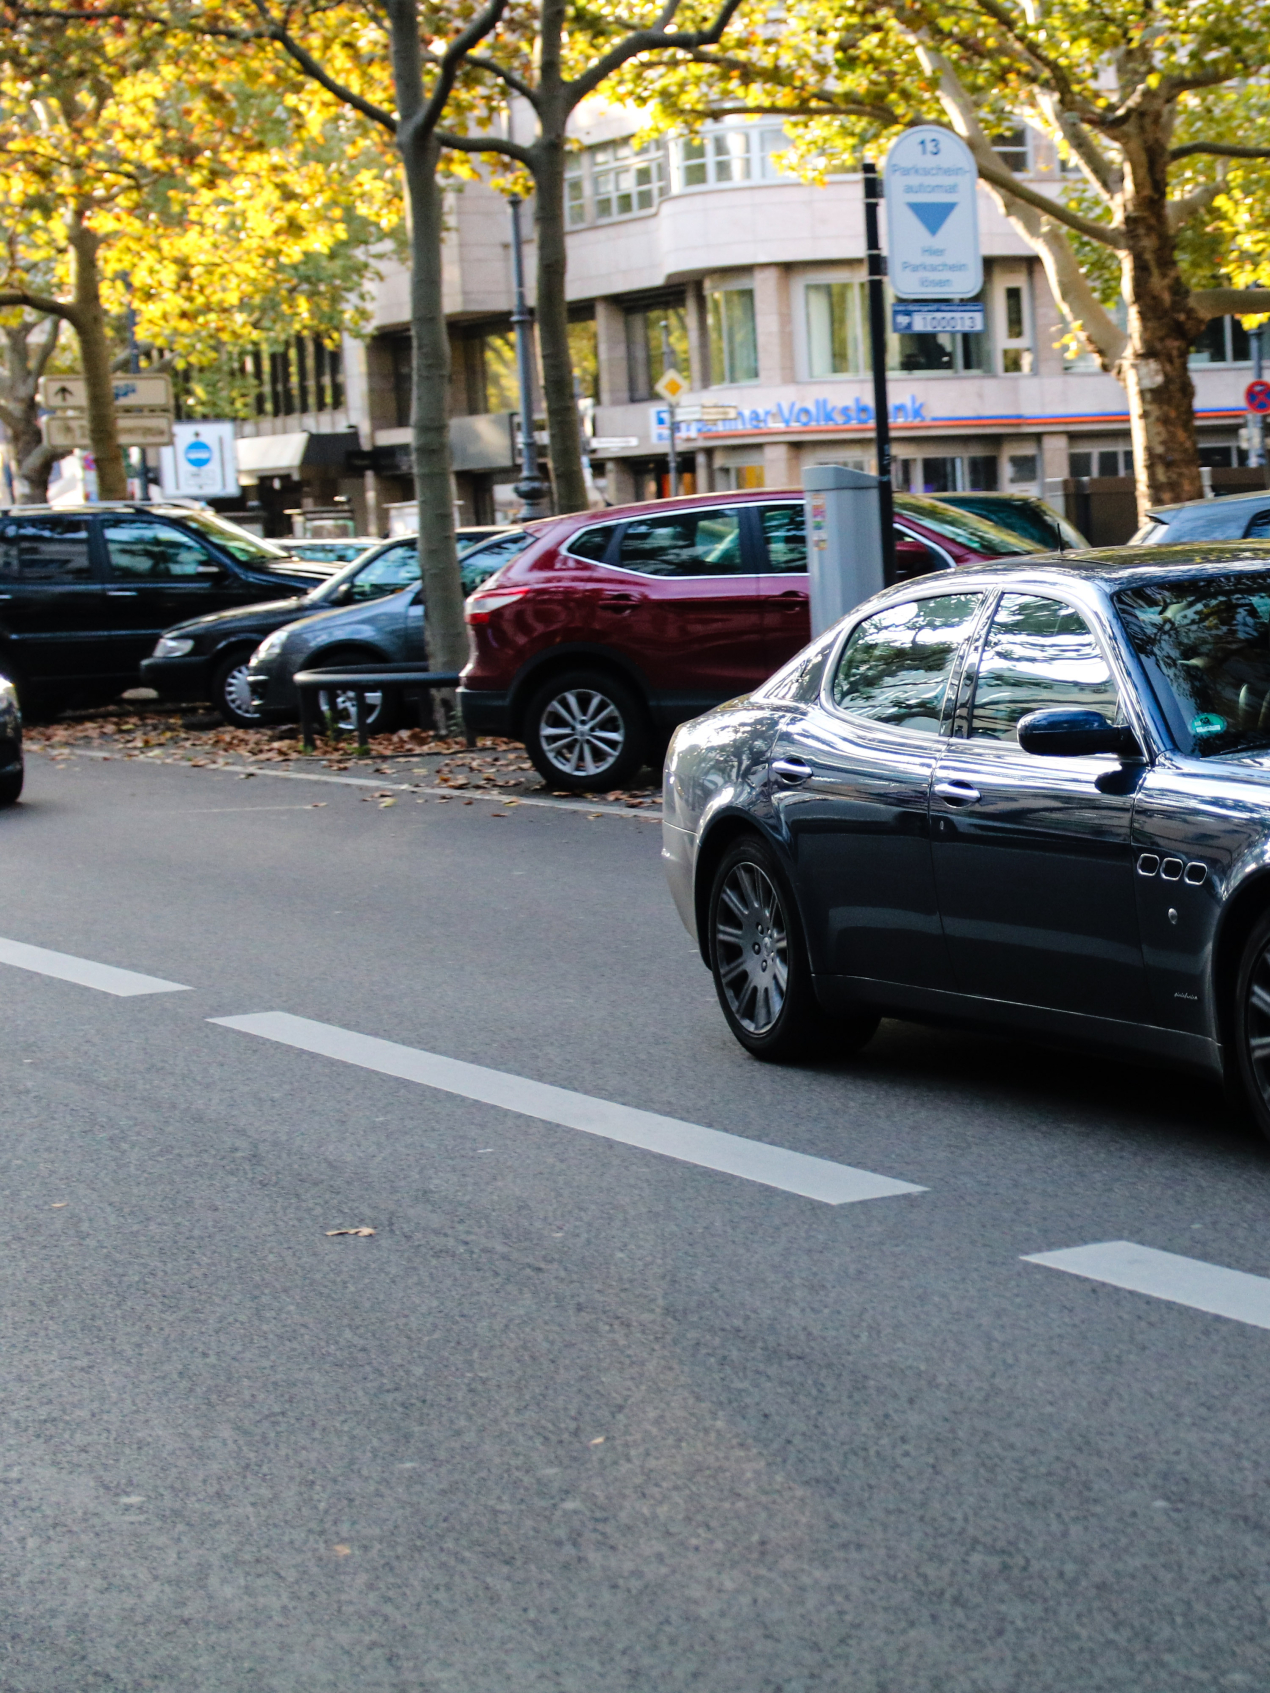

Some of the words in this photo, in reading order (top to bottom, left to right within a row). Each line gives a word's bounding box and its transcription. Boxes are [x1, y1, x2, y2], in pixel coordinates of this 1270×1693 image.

[918, 138, 941, 155] 13
[891, 163, 970, 176] Parkschein-
[903, 182, 959, 194] automat
[920, 245, 946, 256] Hier
[901, 261, 968, 272] Parkschein
[919, 276, 953, 287] lösen
[921, 316, 978, 329] 100013
[777, 395, 925, 427] Volksbnk
